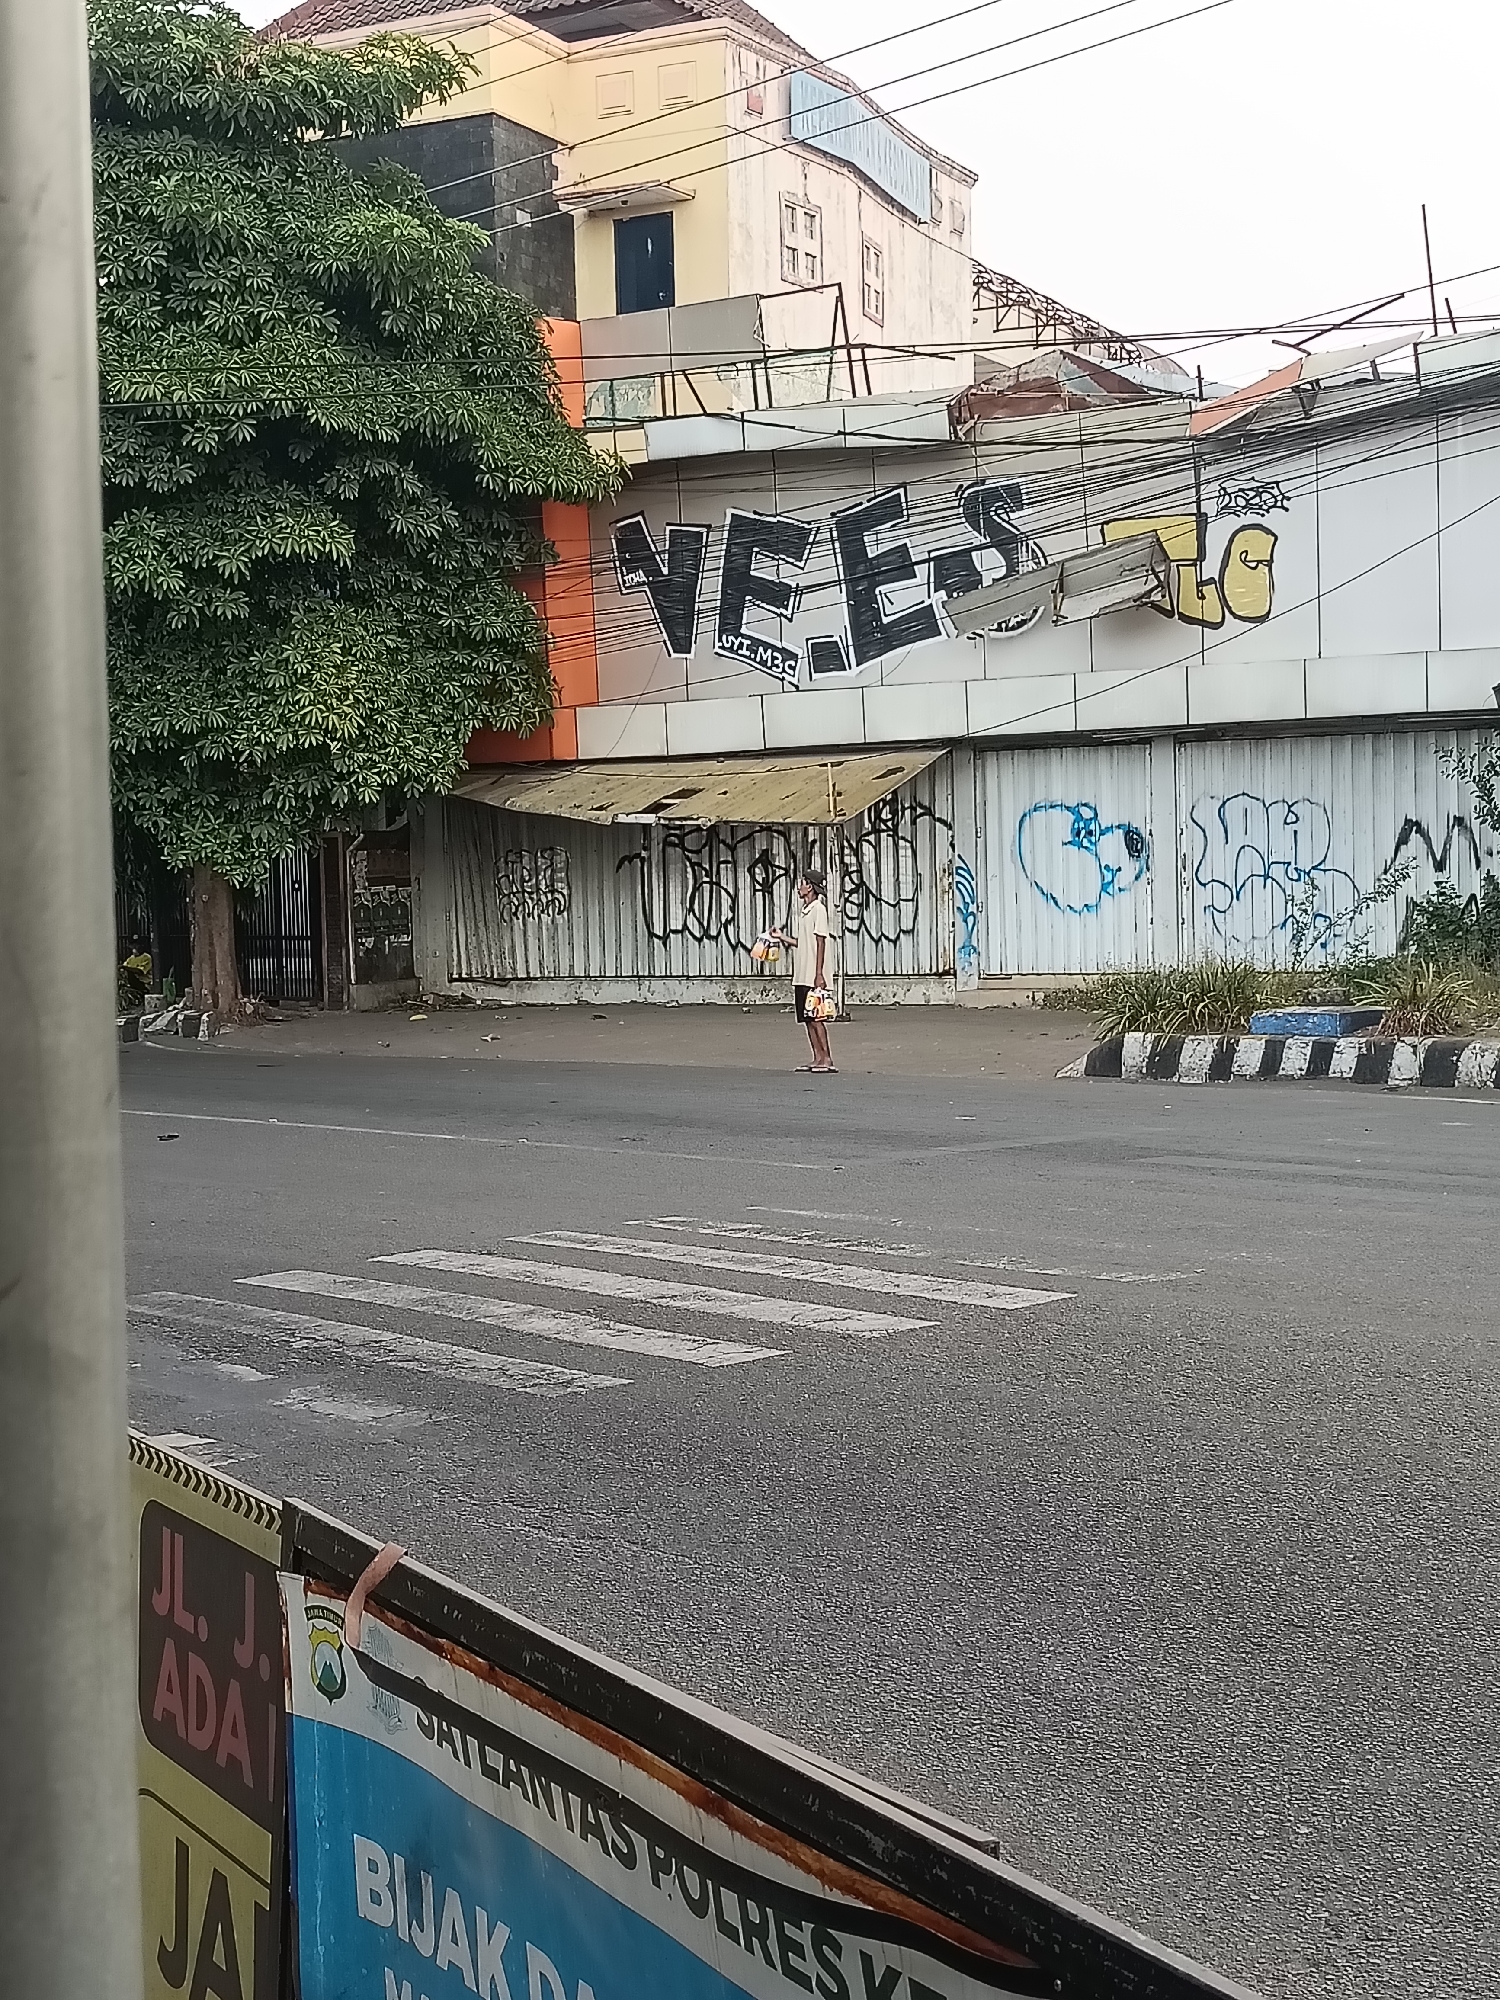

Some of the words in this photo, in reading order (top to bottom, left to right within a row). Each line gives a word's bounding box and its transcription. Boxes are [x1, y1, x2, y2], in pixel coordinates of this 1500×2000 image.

[152, 1526, 208, 1642] JL.
[233, 1572, 271, 1682] J.
[307, 1608, 324, 1619] JAWA
[152, 1637, 254, 1789] ADA
[353, 1833, 511, 2000] BIJAK
[647, 1838, 850, 2000] POLRES
